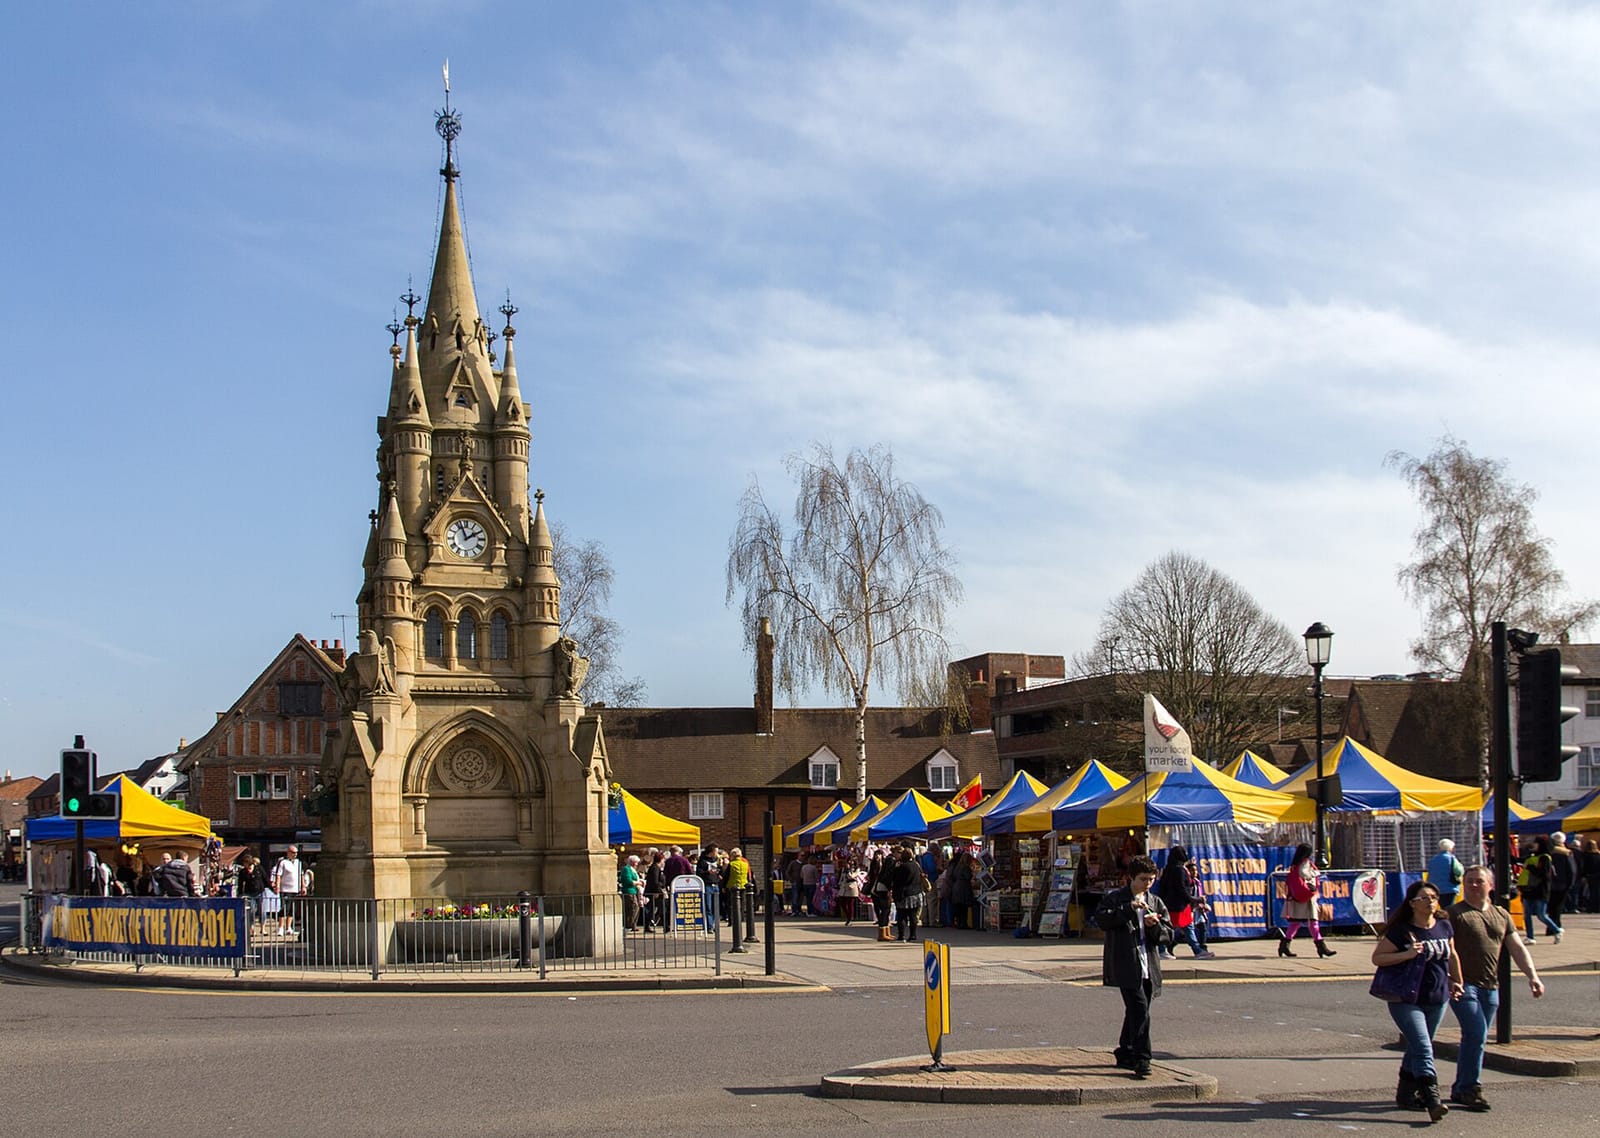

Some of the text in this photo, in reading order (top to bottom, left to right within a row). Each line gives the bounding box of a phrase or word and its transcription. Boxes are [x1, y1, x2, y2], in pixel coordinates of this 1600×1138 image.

[1149, 745, 1167, 755] your
[1149, 756, 1188, 766] market
[1201, 859, 1267, 874] STRATFORD
[1203, 880, 1237, 896] UPON
[1323, 881, 1350, 899] OPEN
[1213, 901, 1264, 917] MARKETS
[129, 907, 142, 945] OF
[143, 908, 167, 945] THE
[169, 908, 199, 947] YEAR
[200, 908, 238, 948] 2014
